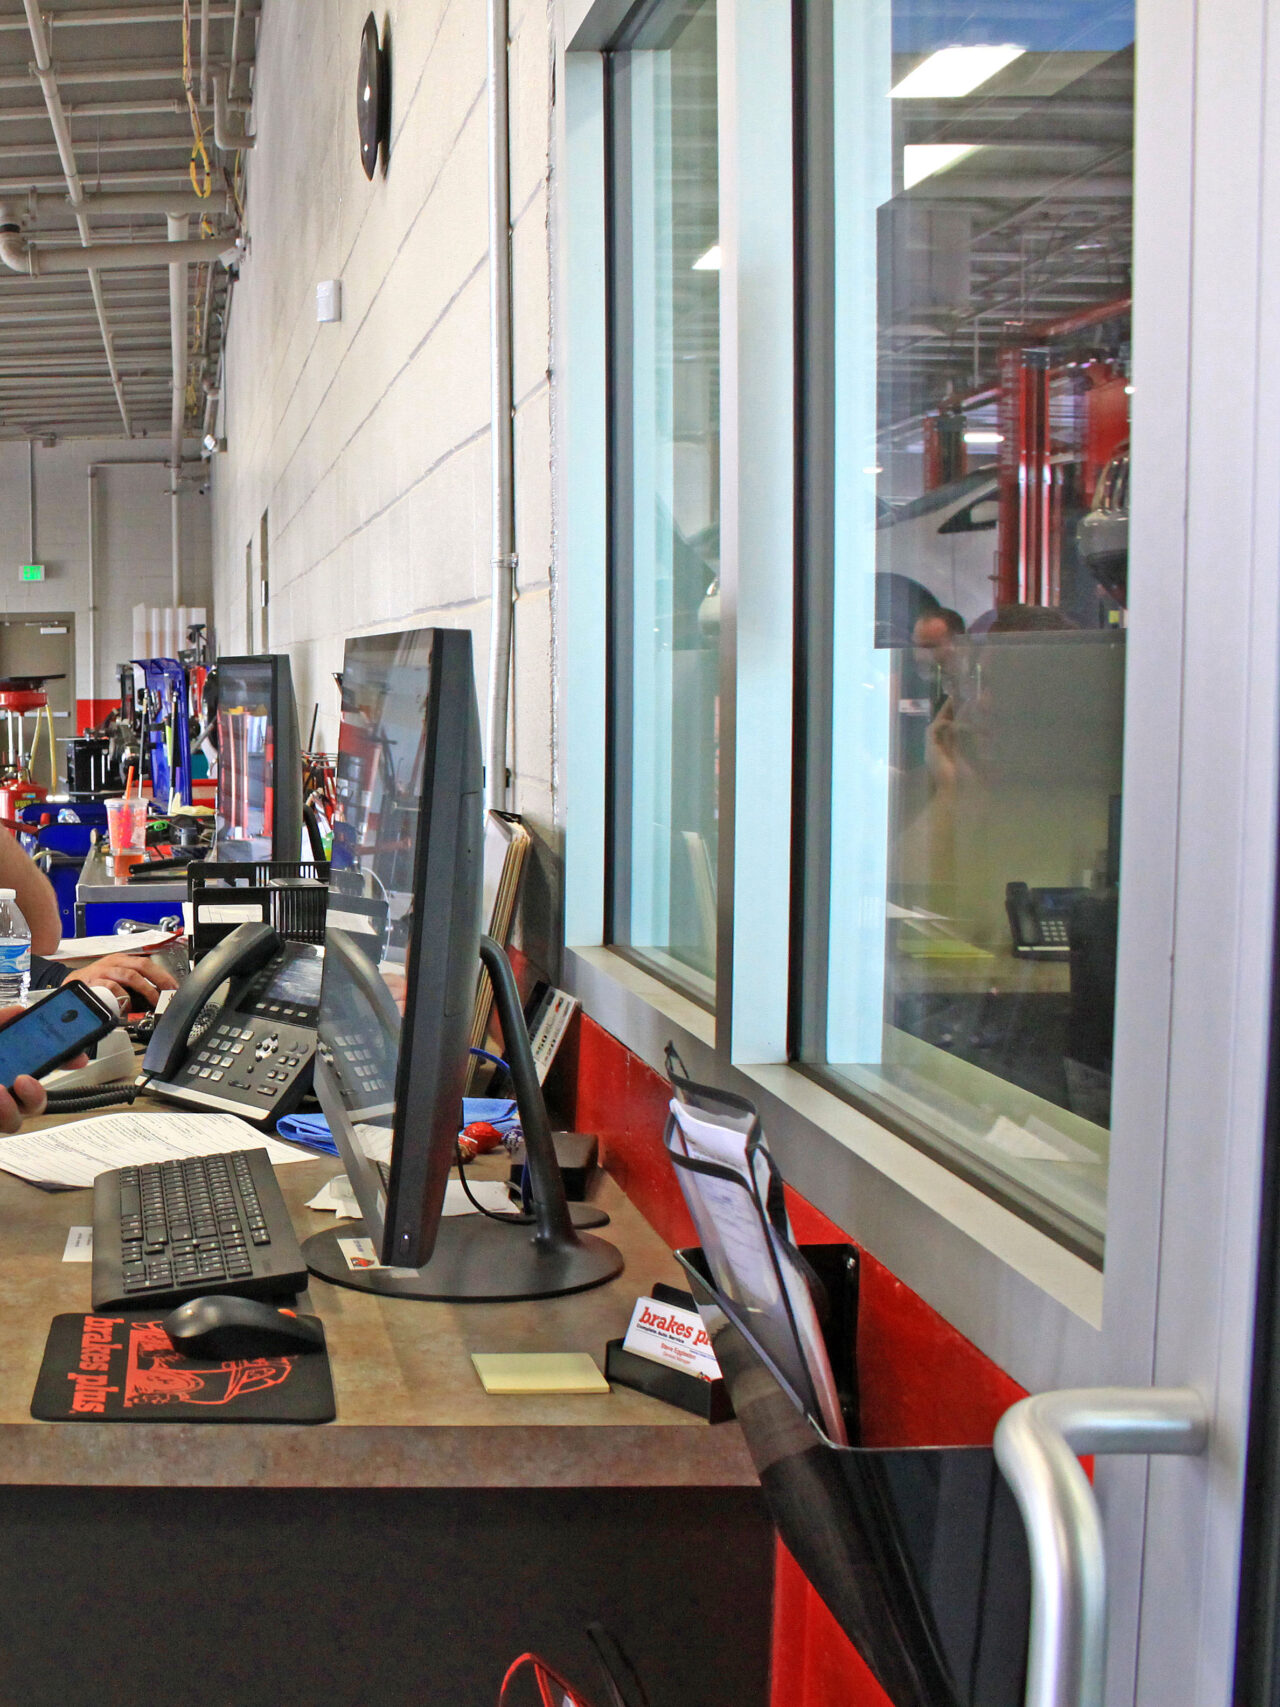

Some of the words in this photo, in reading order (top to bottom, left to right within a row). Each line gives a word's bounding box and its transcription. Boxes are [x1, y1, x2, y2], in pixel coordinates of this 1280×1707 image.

[639, 1306, 694, 1338] brakes
[79, 1316, 124, 1371] brakes
[67, 1372, 120, 1412] plus
